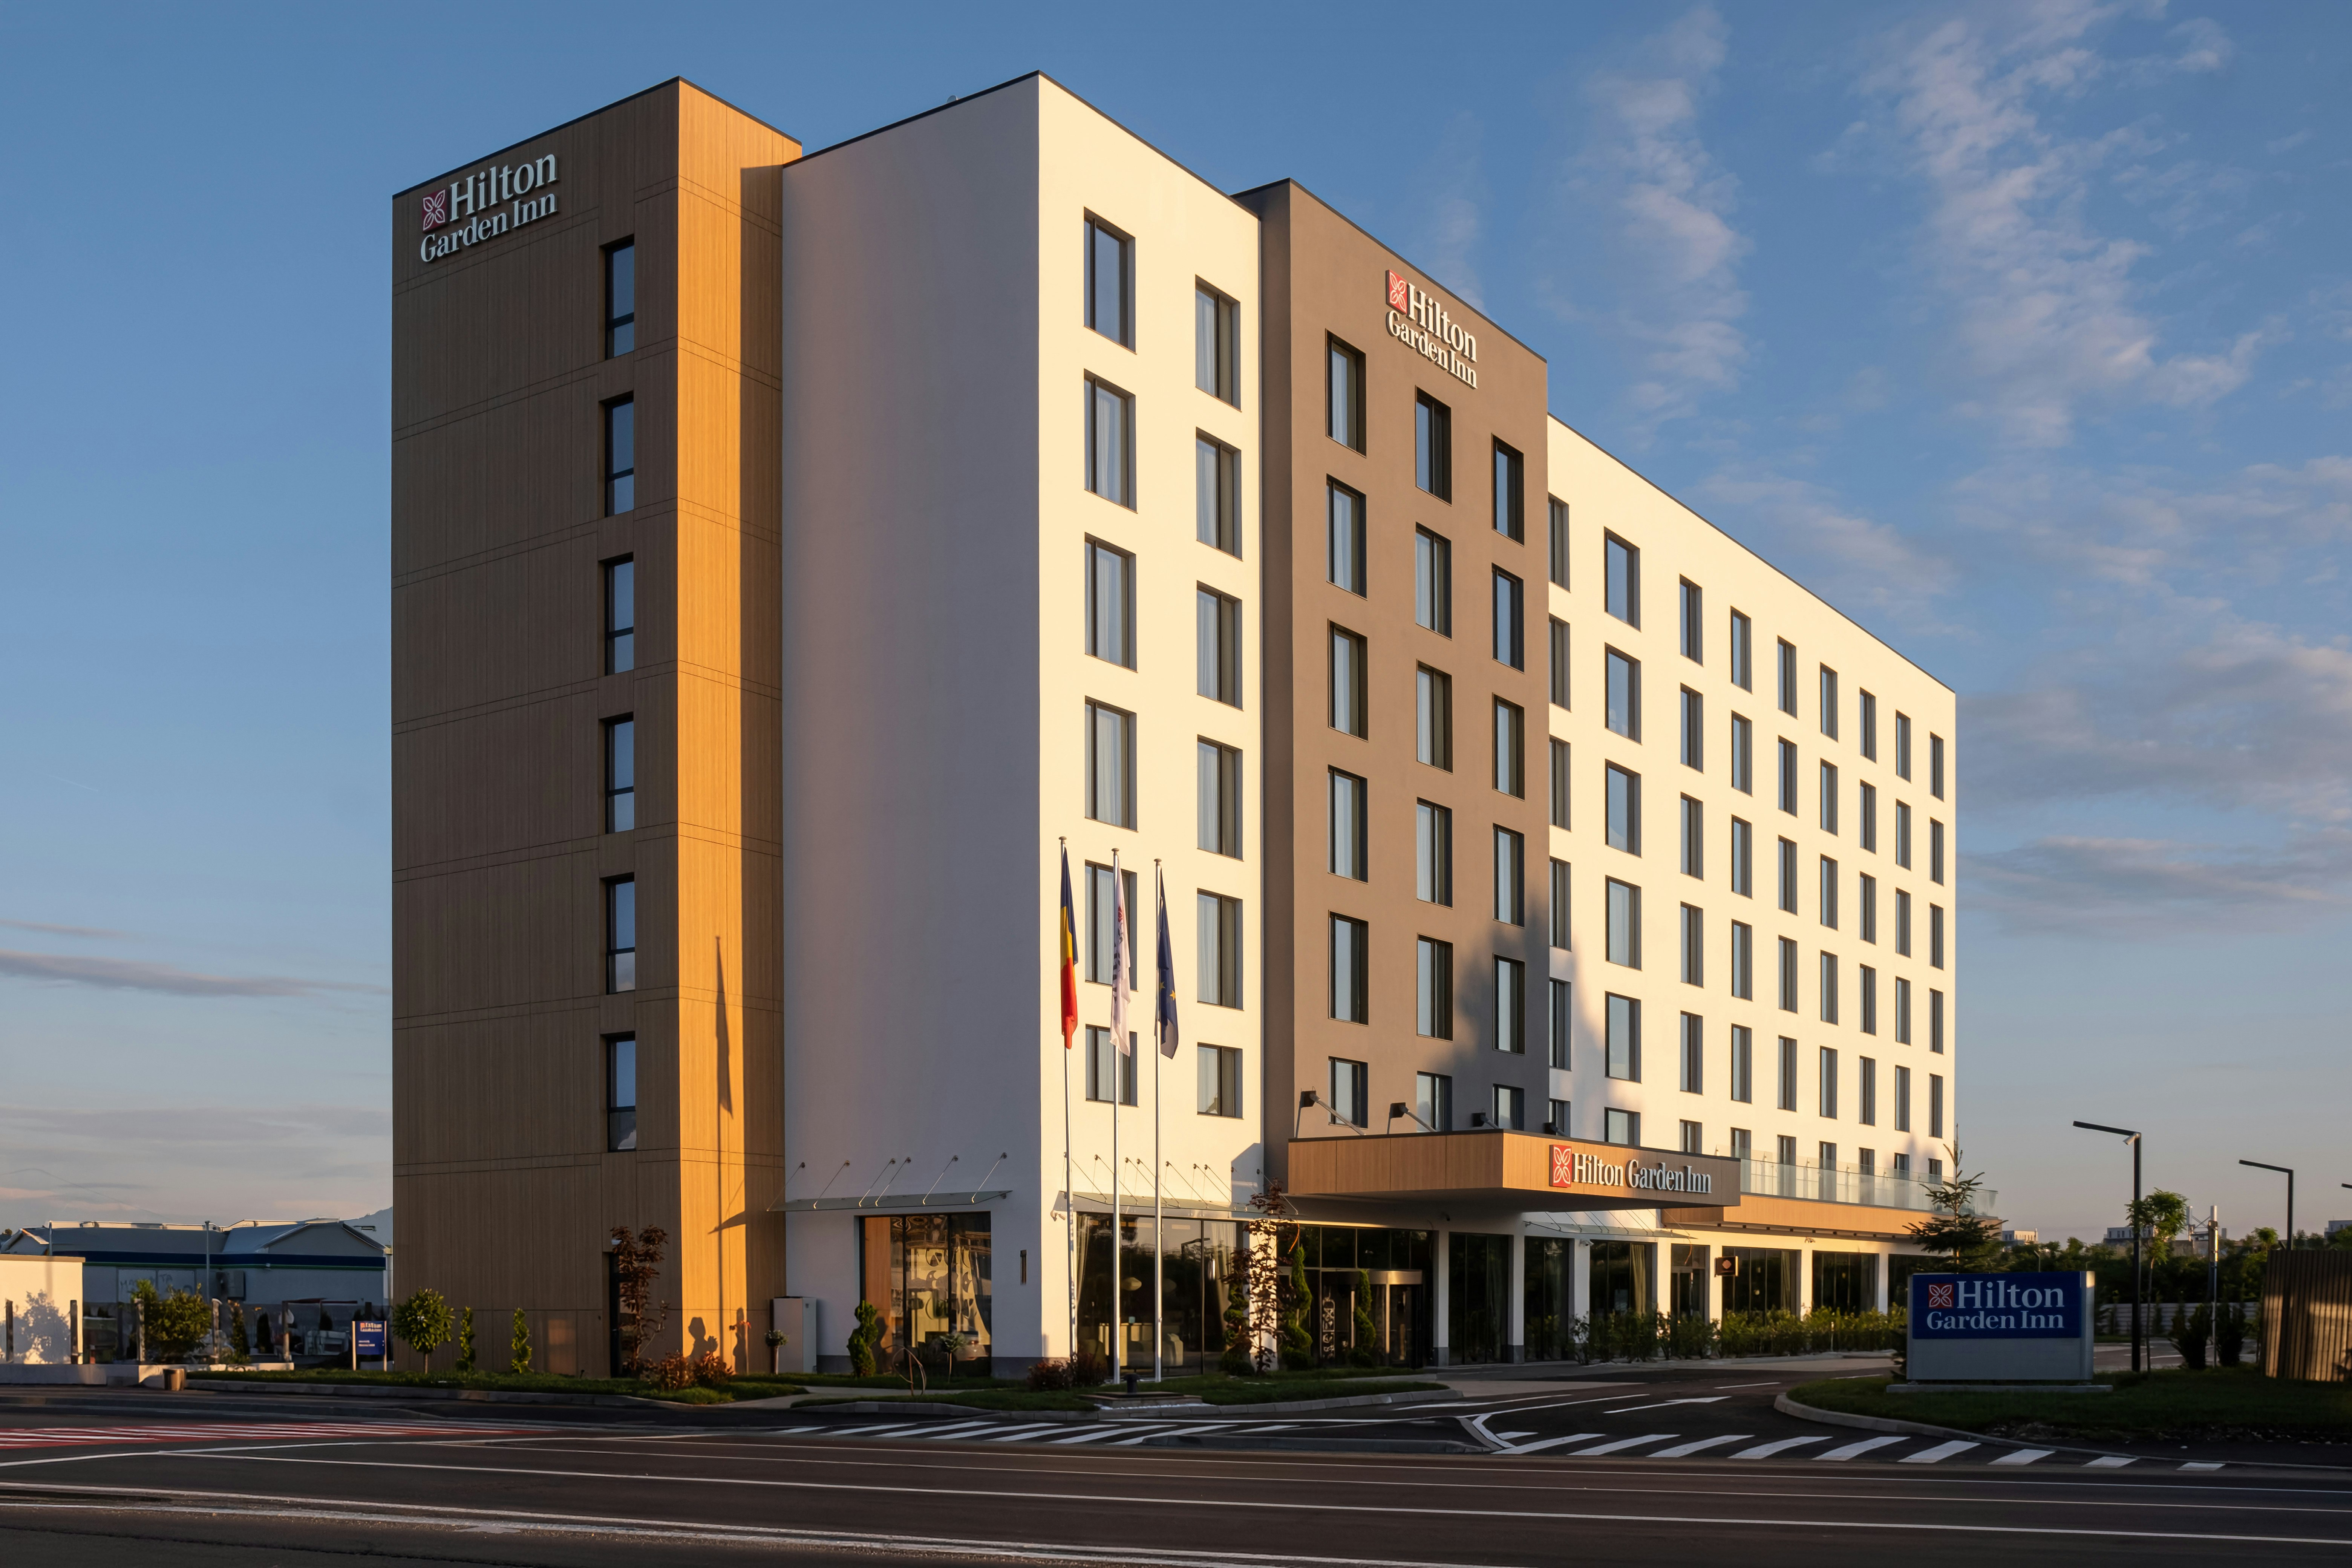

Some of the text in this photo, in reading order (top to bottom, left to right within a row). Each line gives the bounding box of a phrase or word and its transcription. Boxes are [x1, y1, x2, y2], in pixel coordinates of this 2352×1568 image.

[450, 154, 559, 222] Hilton
[421, 193, 558, 262] Garden Inn
[1387, 310, 1478, 389] Garden Inn
[1407, 283, 1477, 363] Hilton
[1572, 1153, 1712, 1193] Hilton Garden Inn
[1927, 1311, 2064, 1329] Garden Inn
[1957, 1280, 2065, 1308] Hilton
